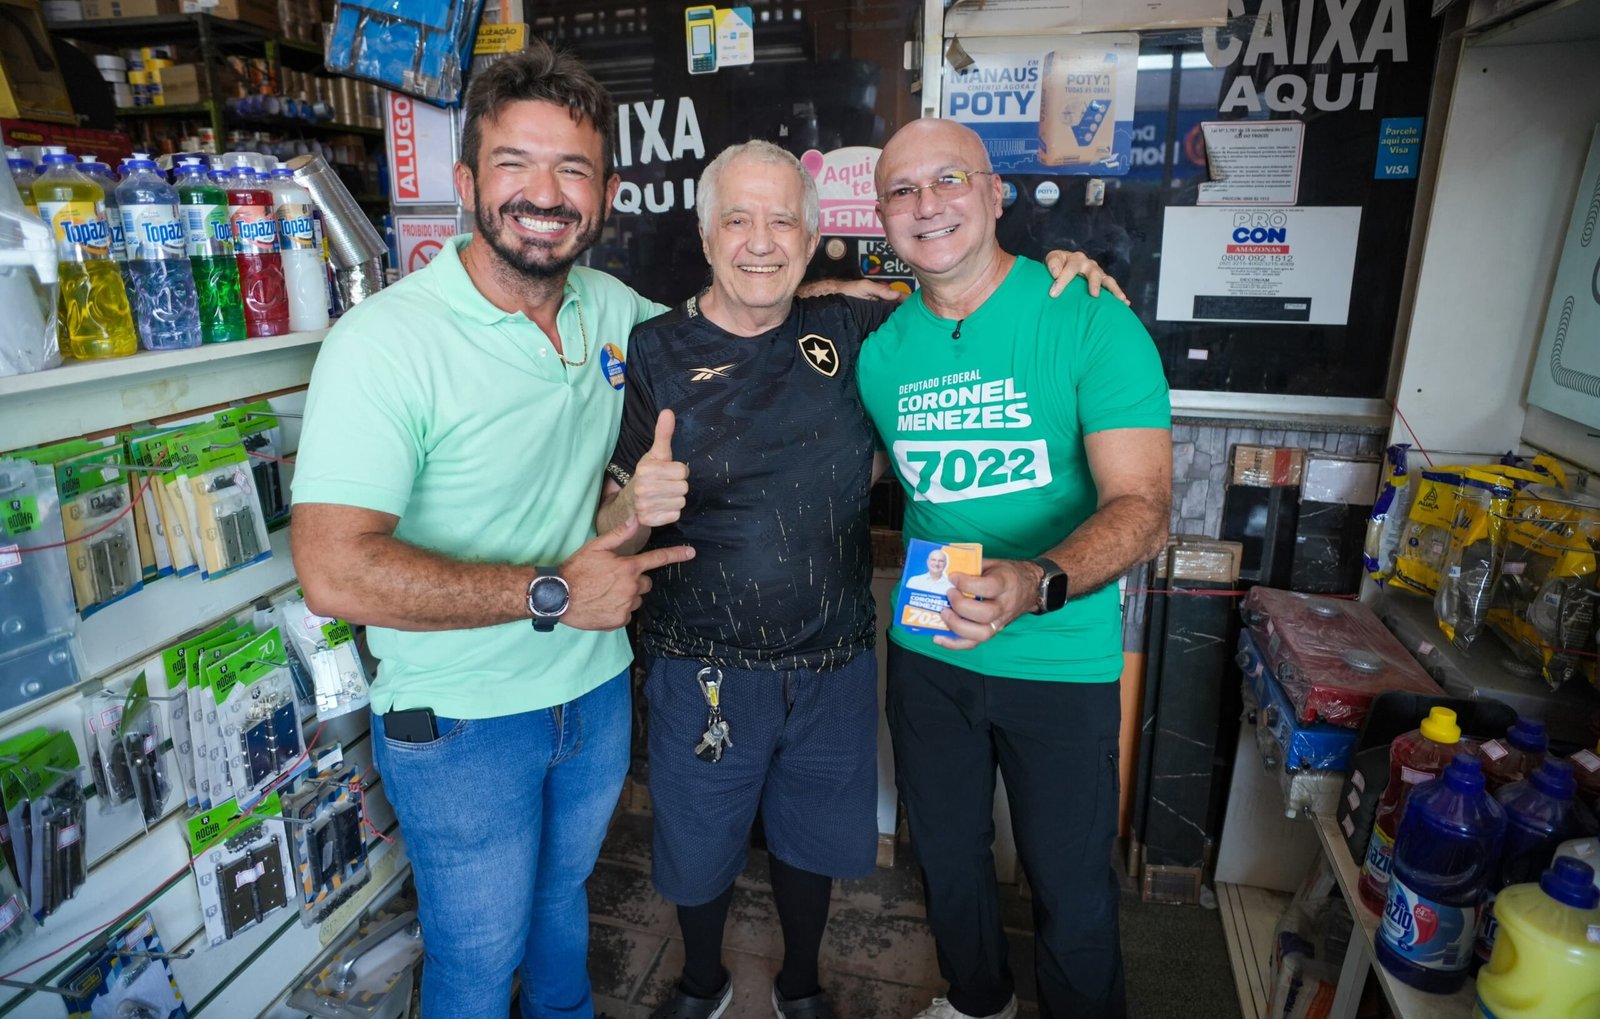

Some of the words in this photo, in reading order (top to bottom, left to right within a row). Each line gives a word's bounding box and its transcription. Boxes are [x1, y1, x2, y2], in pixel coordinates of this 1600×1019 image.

[1201, 0, 1408, 68] CAIXA
[950, 68, 1039, 84] MANAUS
[1066, 74, 1100, 85] POTY
[1219, 72, 1379, 115] AQUI
[950, 91, 1036, 117] POTY
[612, 96, 706, 167] IXA
[1385, 127, 1417, 135] Parcele
[394, 97, 417, 193] ALUGO
[1381, 137, 1400, 146] aqui
[1390, 146, 1409, 154] Visa
[823, 156, 872, 185] Aqui
[1385, 165, 1409, 174] VISA
[611, 177, 697, 214] QUI
[852, 180, 878, 196] te
[1232, 212, 1288, 228] PRO
[60, 218, 109, 246] Topázi
[141, 219, 184, 246] Topázi
[402, 223, 432, 237] PROIBIDO
[433, 223, 456, 238] FUMAR
[1232, 227, 1287, 243] CON
[883, 257, 912, 274] elo
[898, 377, 940, 395] DEPUTADO
[942, 369, 982, 386] FEDERAL
[898, 377, 1027, 413] CORONEL
[897, 402, 1033, 431] MENEZES
[906, 448, 1037, 495] 7022
[8, 512, 34, 529] ROCHA
[907, 607, 948, 627] 702
[328, 625, 350, 641] ROCHA
[172, 659, 186, 673] ROC
[215, 672, 237, 690] ROCHA
[195, 822, 220, 841] ROCHA
[1385, 897, 1413, 931] ázio
